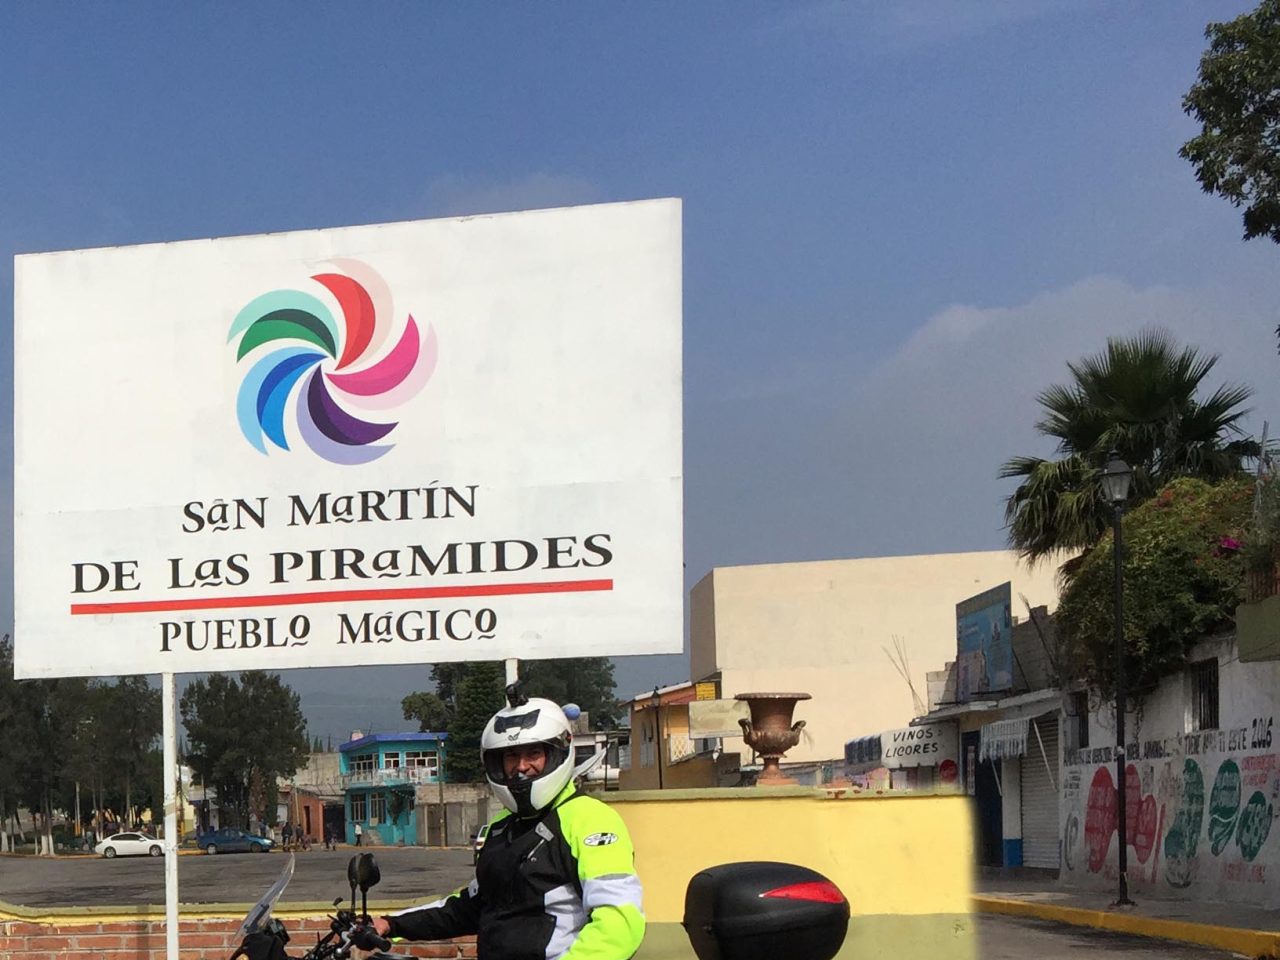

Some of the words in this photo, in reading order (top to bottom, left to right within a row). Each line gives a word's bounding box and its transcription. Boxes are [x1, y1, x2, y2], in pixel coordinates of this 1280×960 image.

[71, 560, 142, 594] DE
[159, 614, 311, 652] PUEBLO
[893, 728, 934, 743] VINOS
[1251, 716, 1273, 749] 2016
[885, 742, 939, 758] LICORES
